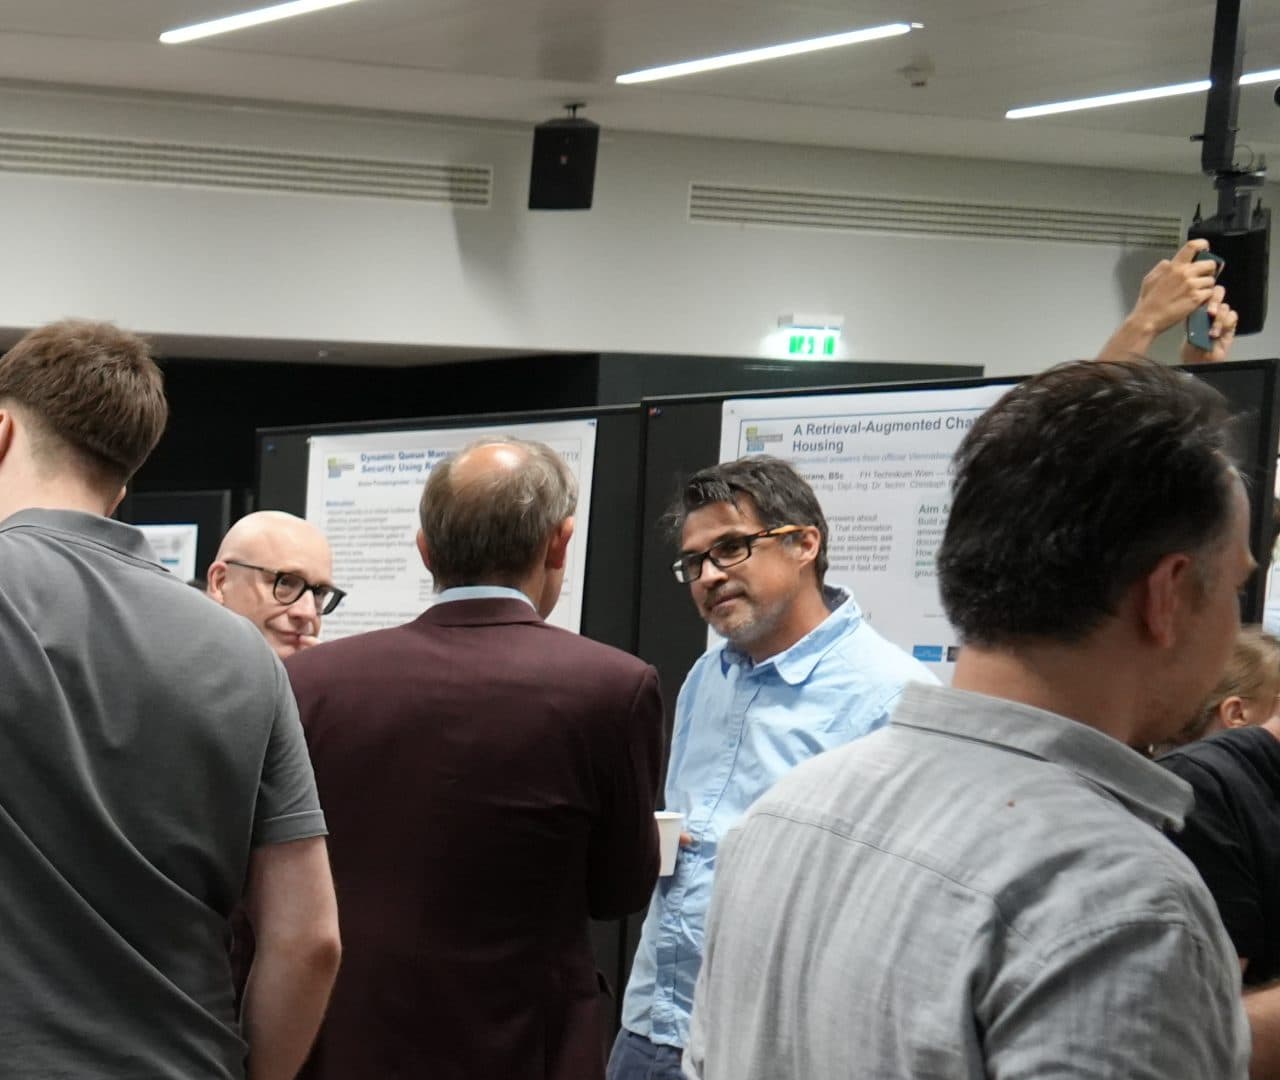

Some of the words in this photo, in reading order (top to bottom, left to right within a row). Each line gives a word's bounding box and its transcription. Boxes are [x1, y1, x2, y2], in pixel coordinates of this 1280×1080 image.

[793, 424, 803, 436] A
[806, 418, 941, 437] Retrieval-Augmented
[945, 416, 973, 430] Cha
[792, 440, 844, 454] Housing
[361, 452, 395, 463] Dynamic
[398, 450, 425, 461] Queue
[361, 463, 396, 473] Security
[398, 462, 422, 473] Using
[873, 470, 912, 479] Technikum
[919, 504, 939, 514] Aim
[835, 524, 851, 532] That
[852, 523, 893, 532] information
